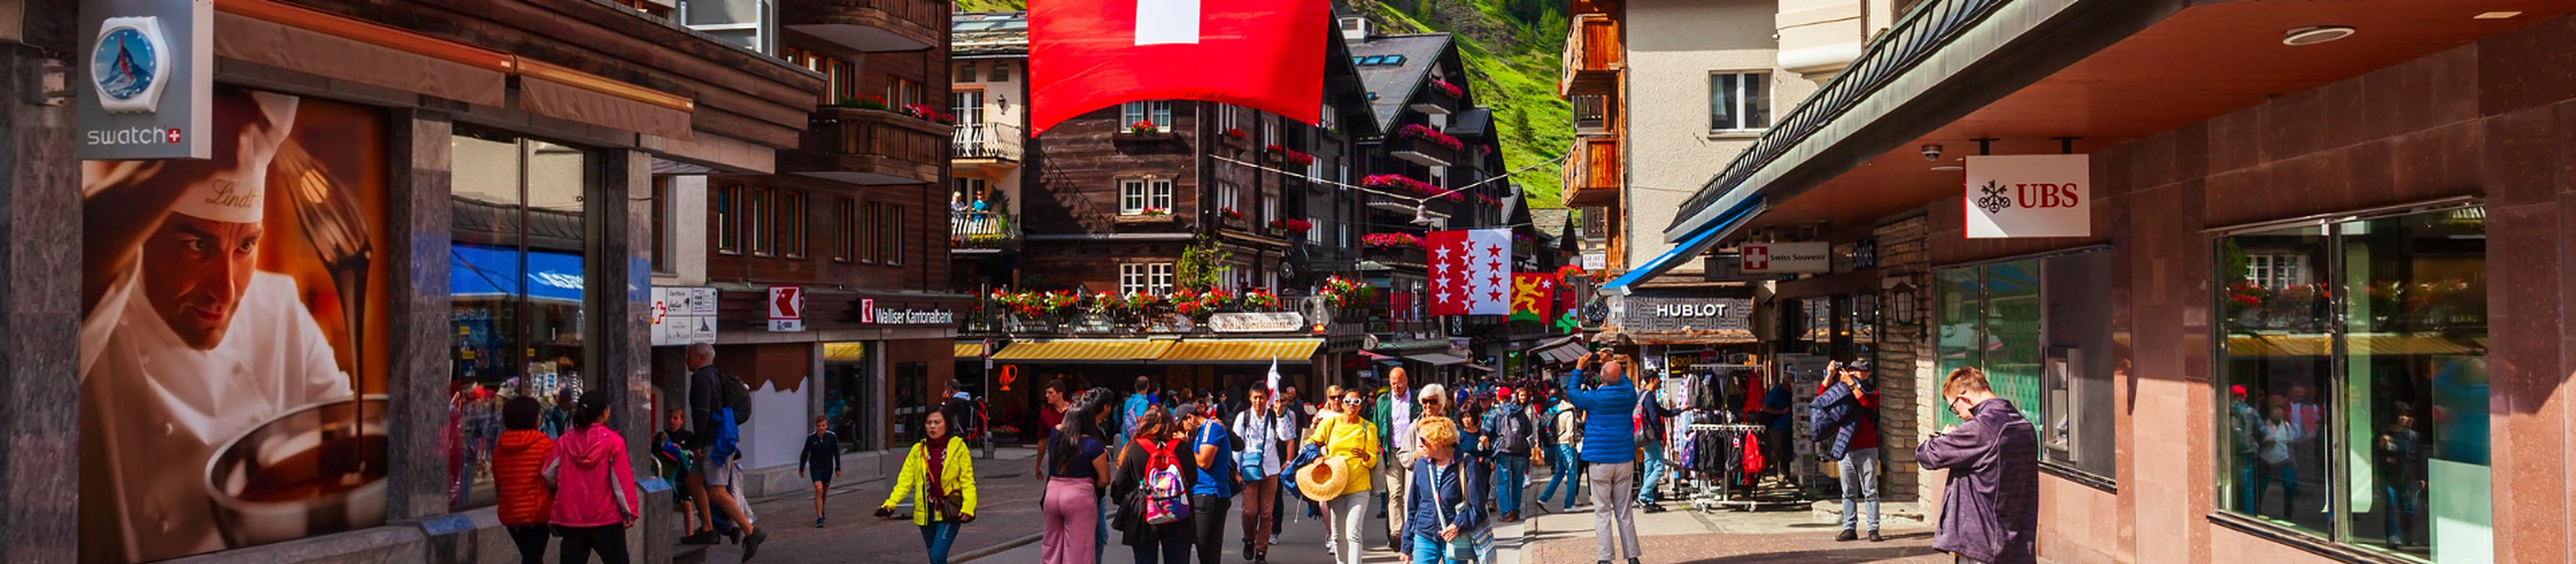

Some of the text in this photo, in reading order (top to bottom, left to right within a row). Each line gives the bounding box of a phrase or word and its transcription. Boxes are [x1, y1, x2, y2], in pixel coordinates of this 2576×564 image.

[87, 126, 166, 145] swatch
[205, 179, 256, 208] Lindt
[2015, 183, 2079, 209] UBS
[875, 308, 953, 324] Walliser Kantonalbank
[1656, 304, 1726, 317] HUBLOT
[1670, 354, 1699, 367] Books
